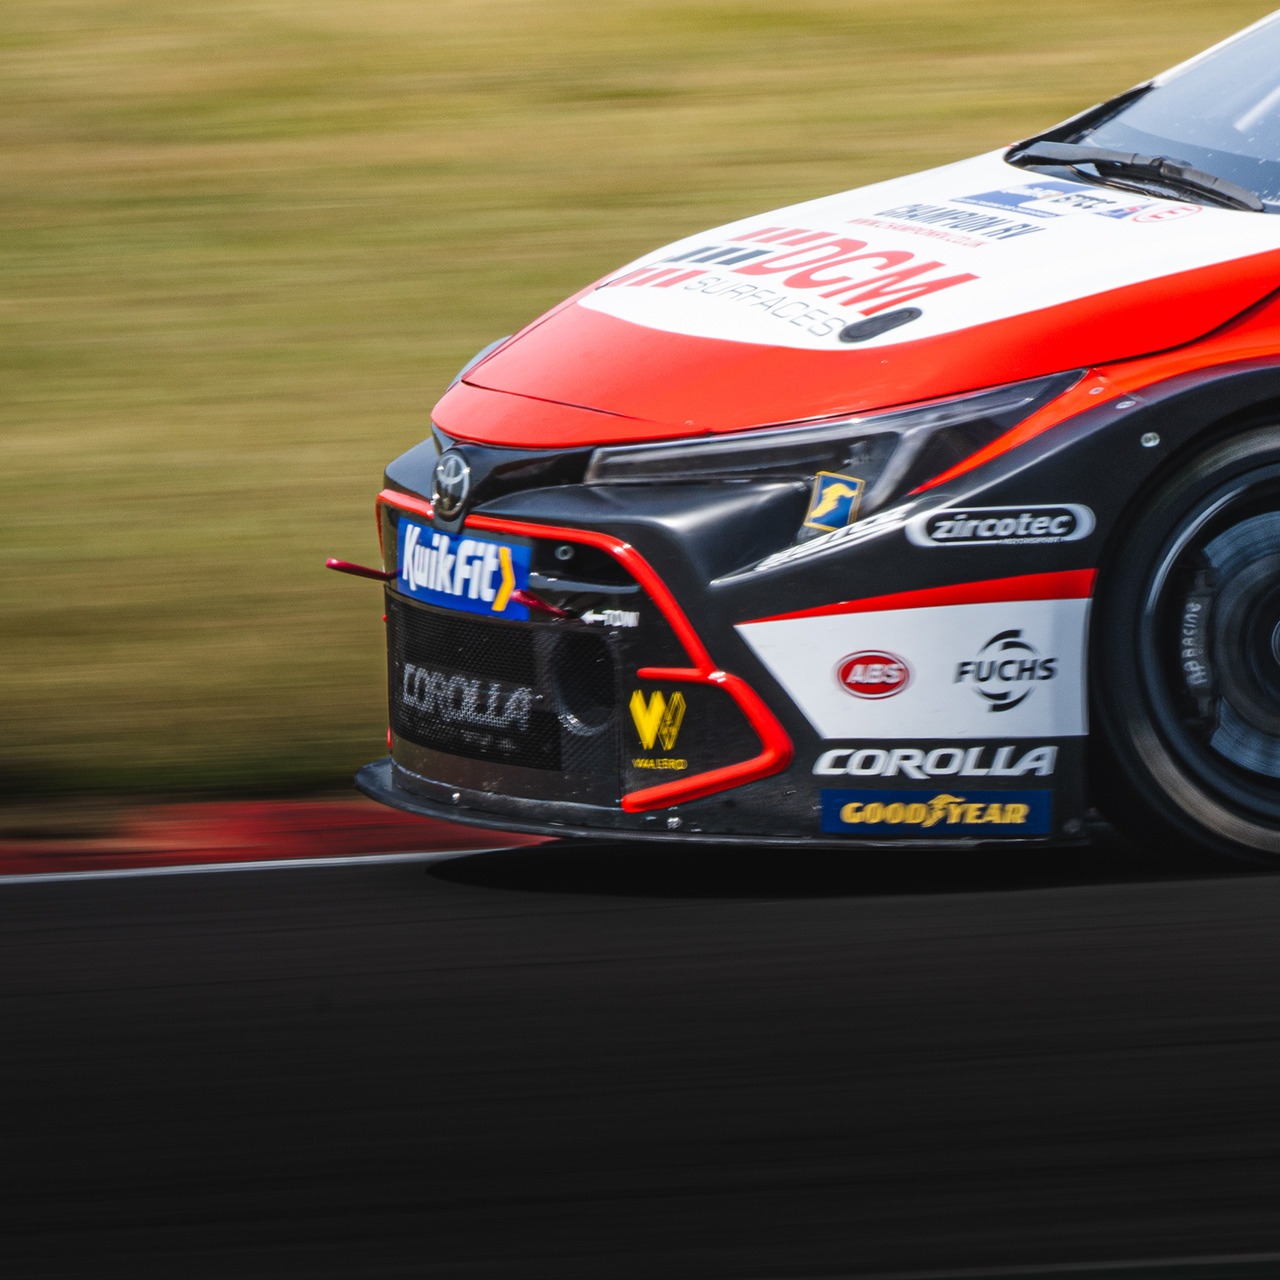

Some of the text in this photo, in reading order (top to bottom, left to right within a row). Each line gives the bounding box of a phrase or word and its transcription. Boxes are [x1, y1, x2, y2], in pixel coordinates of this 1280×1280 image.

[730, 238, 981, 317] DCM
[683, 277, 848, 338] SURFACES
[931, 513, 1073, 539] zircotec
[845, 662, 905, 685] ABS
[952, 657, 1060, 685] FUCHS
[812, 745, 1059, 780] COROLLA
